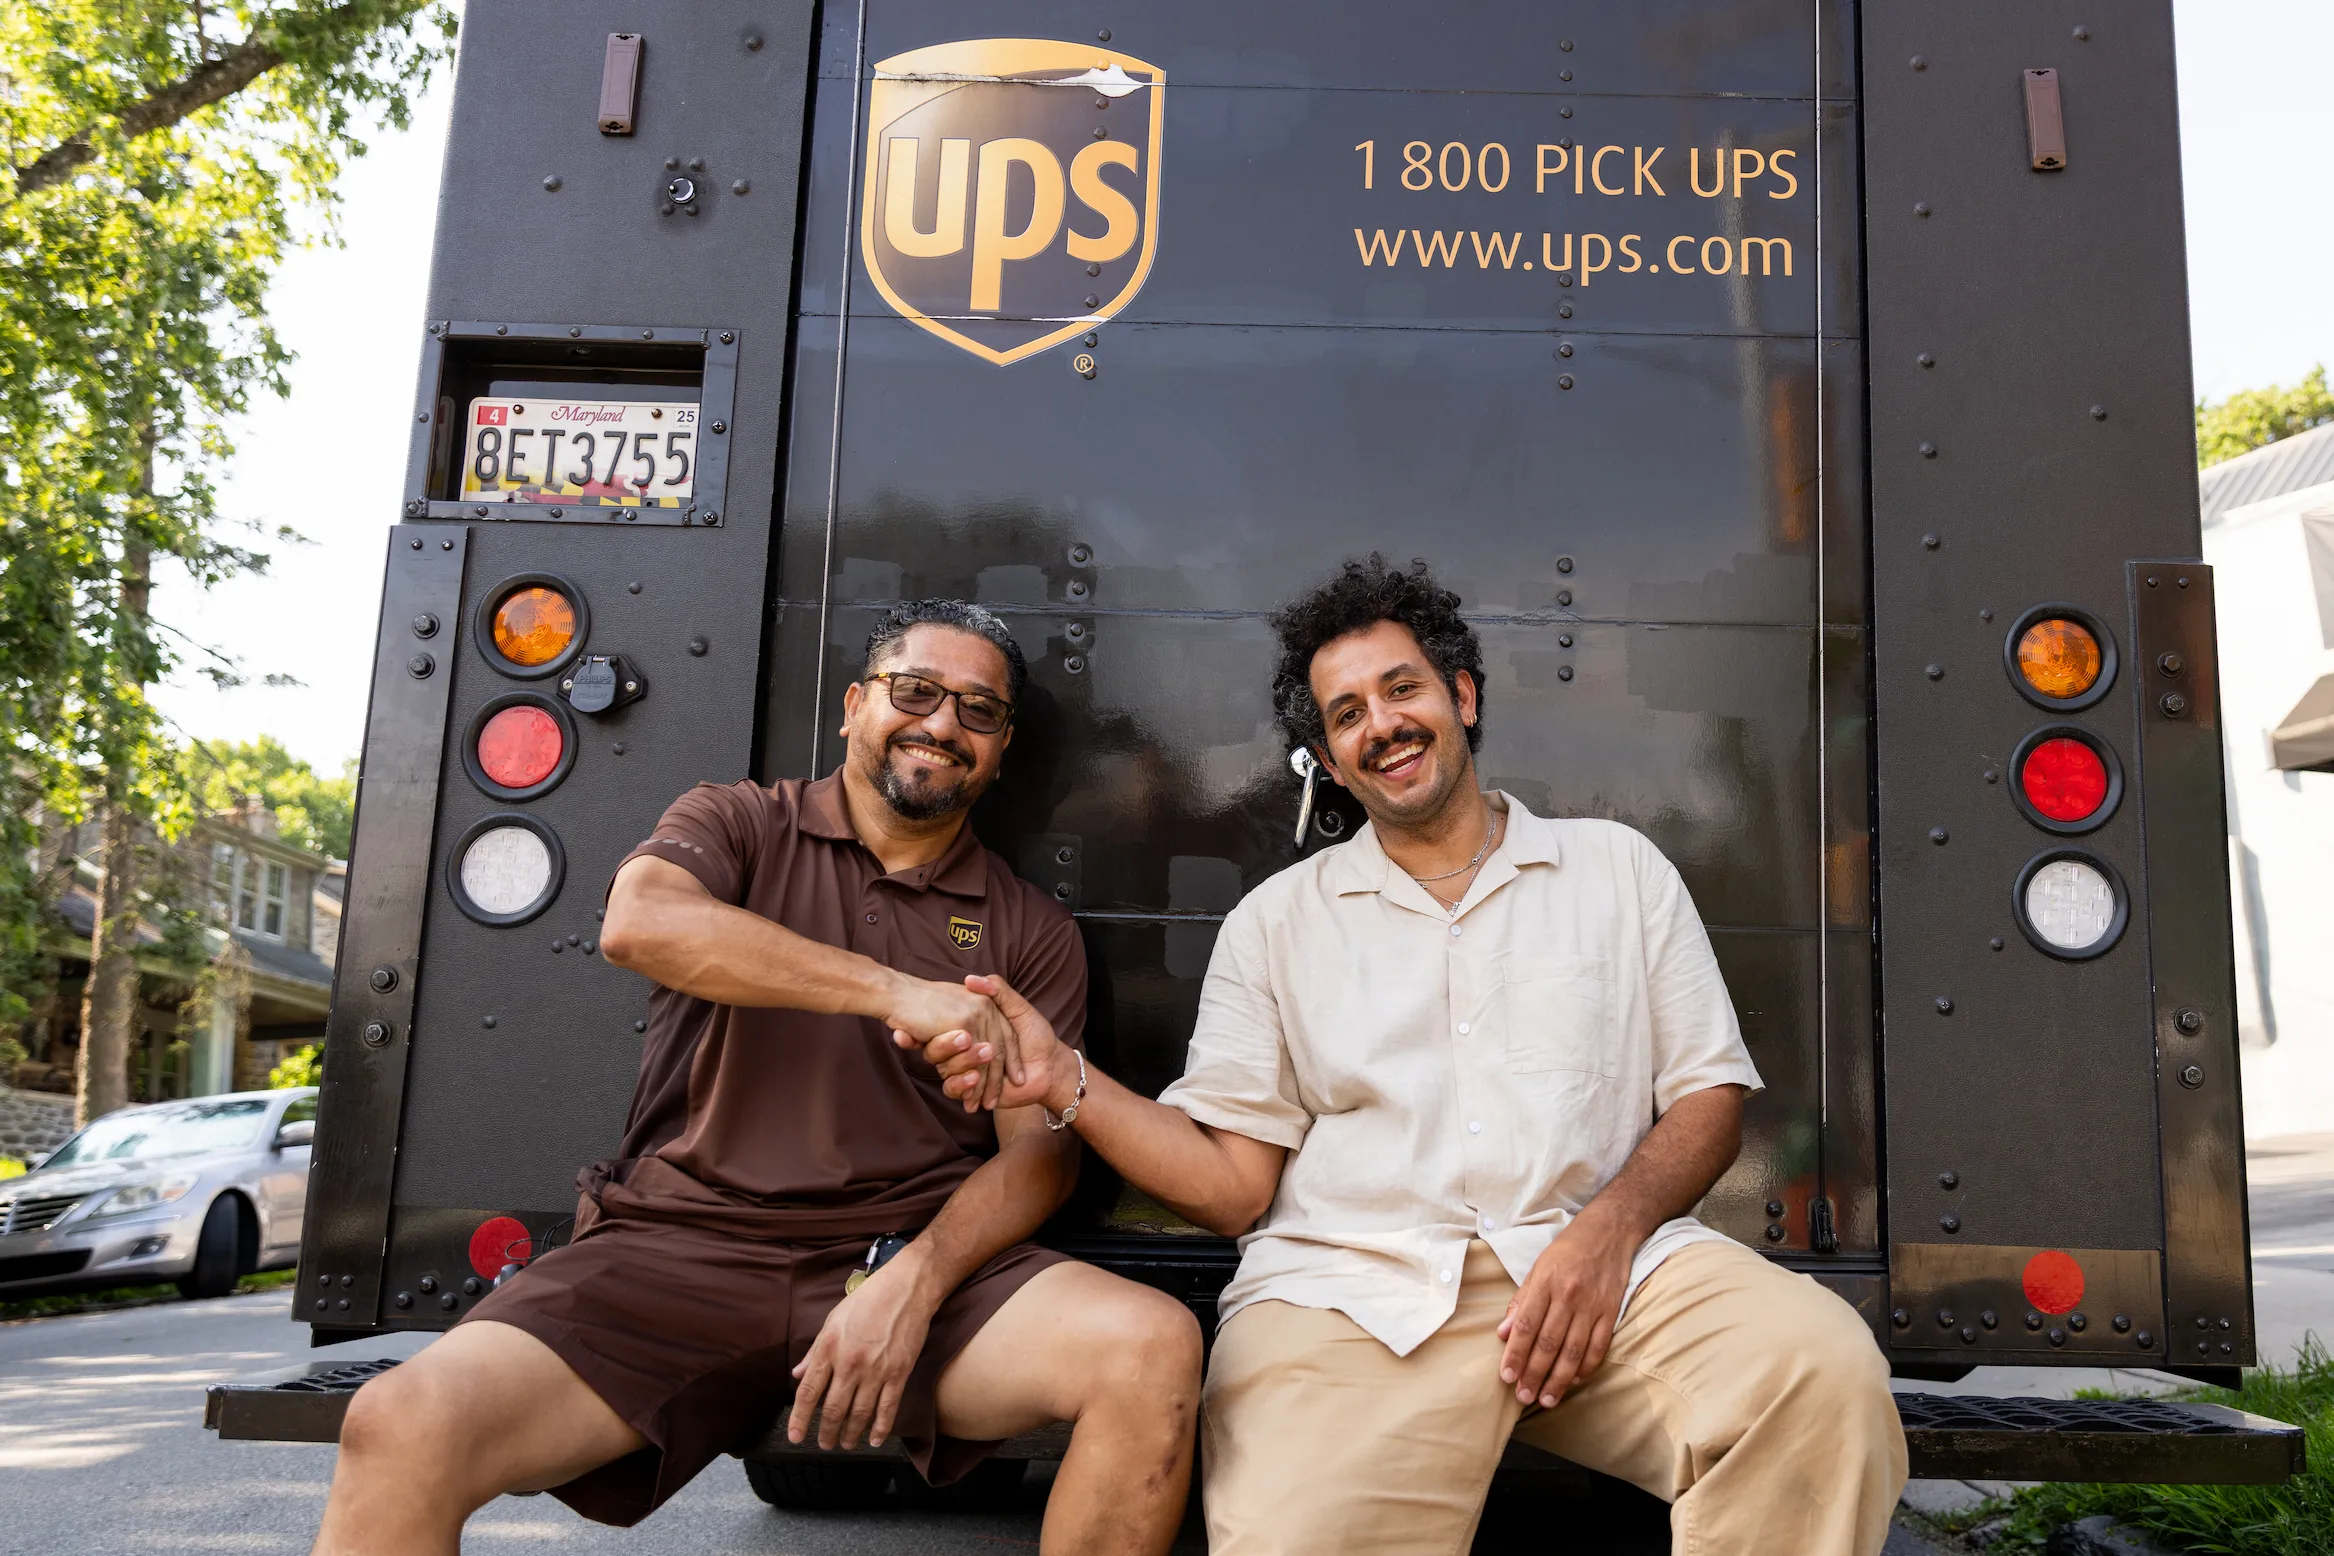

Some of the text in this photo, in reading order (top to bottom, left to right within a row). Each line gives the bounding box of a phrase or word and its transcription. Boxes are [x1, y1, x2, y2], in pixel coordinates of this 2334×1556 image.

[1354, 140, 1798, 200] 1 800 PICK UPS
[884, 137, 1138, 311] ups
[1354, 228, 1793, 287] www.ups.com
[489, 408, 500, 424] 4
[551, 405, 626, 426] Maryland
[676, 410, 695, 423] 25
[475, 427, 692, 486] 8ET3755
[950, 923, 978, 944] ups
